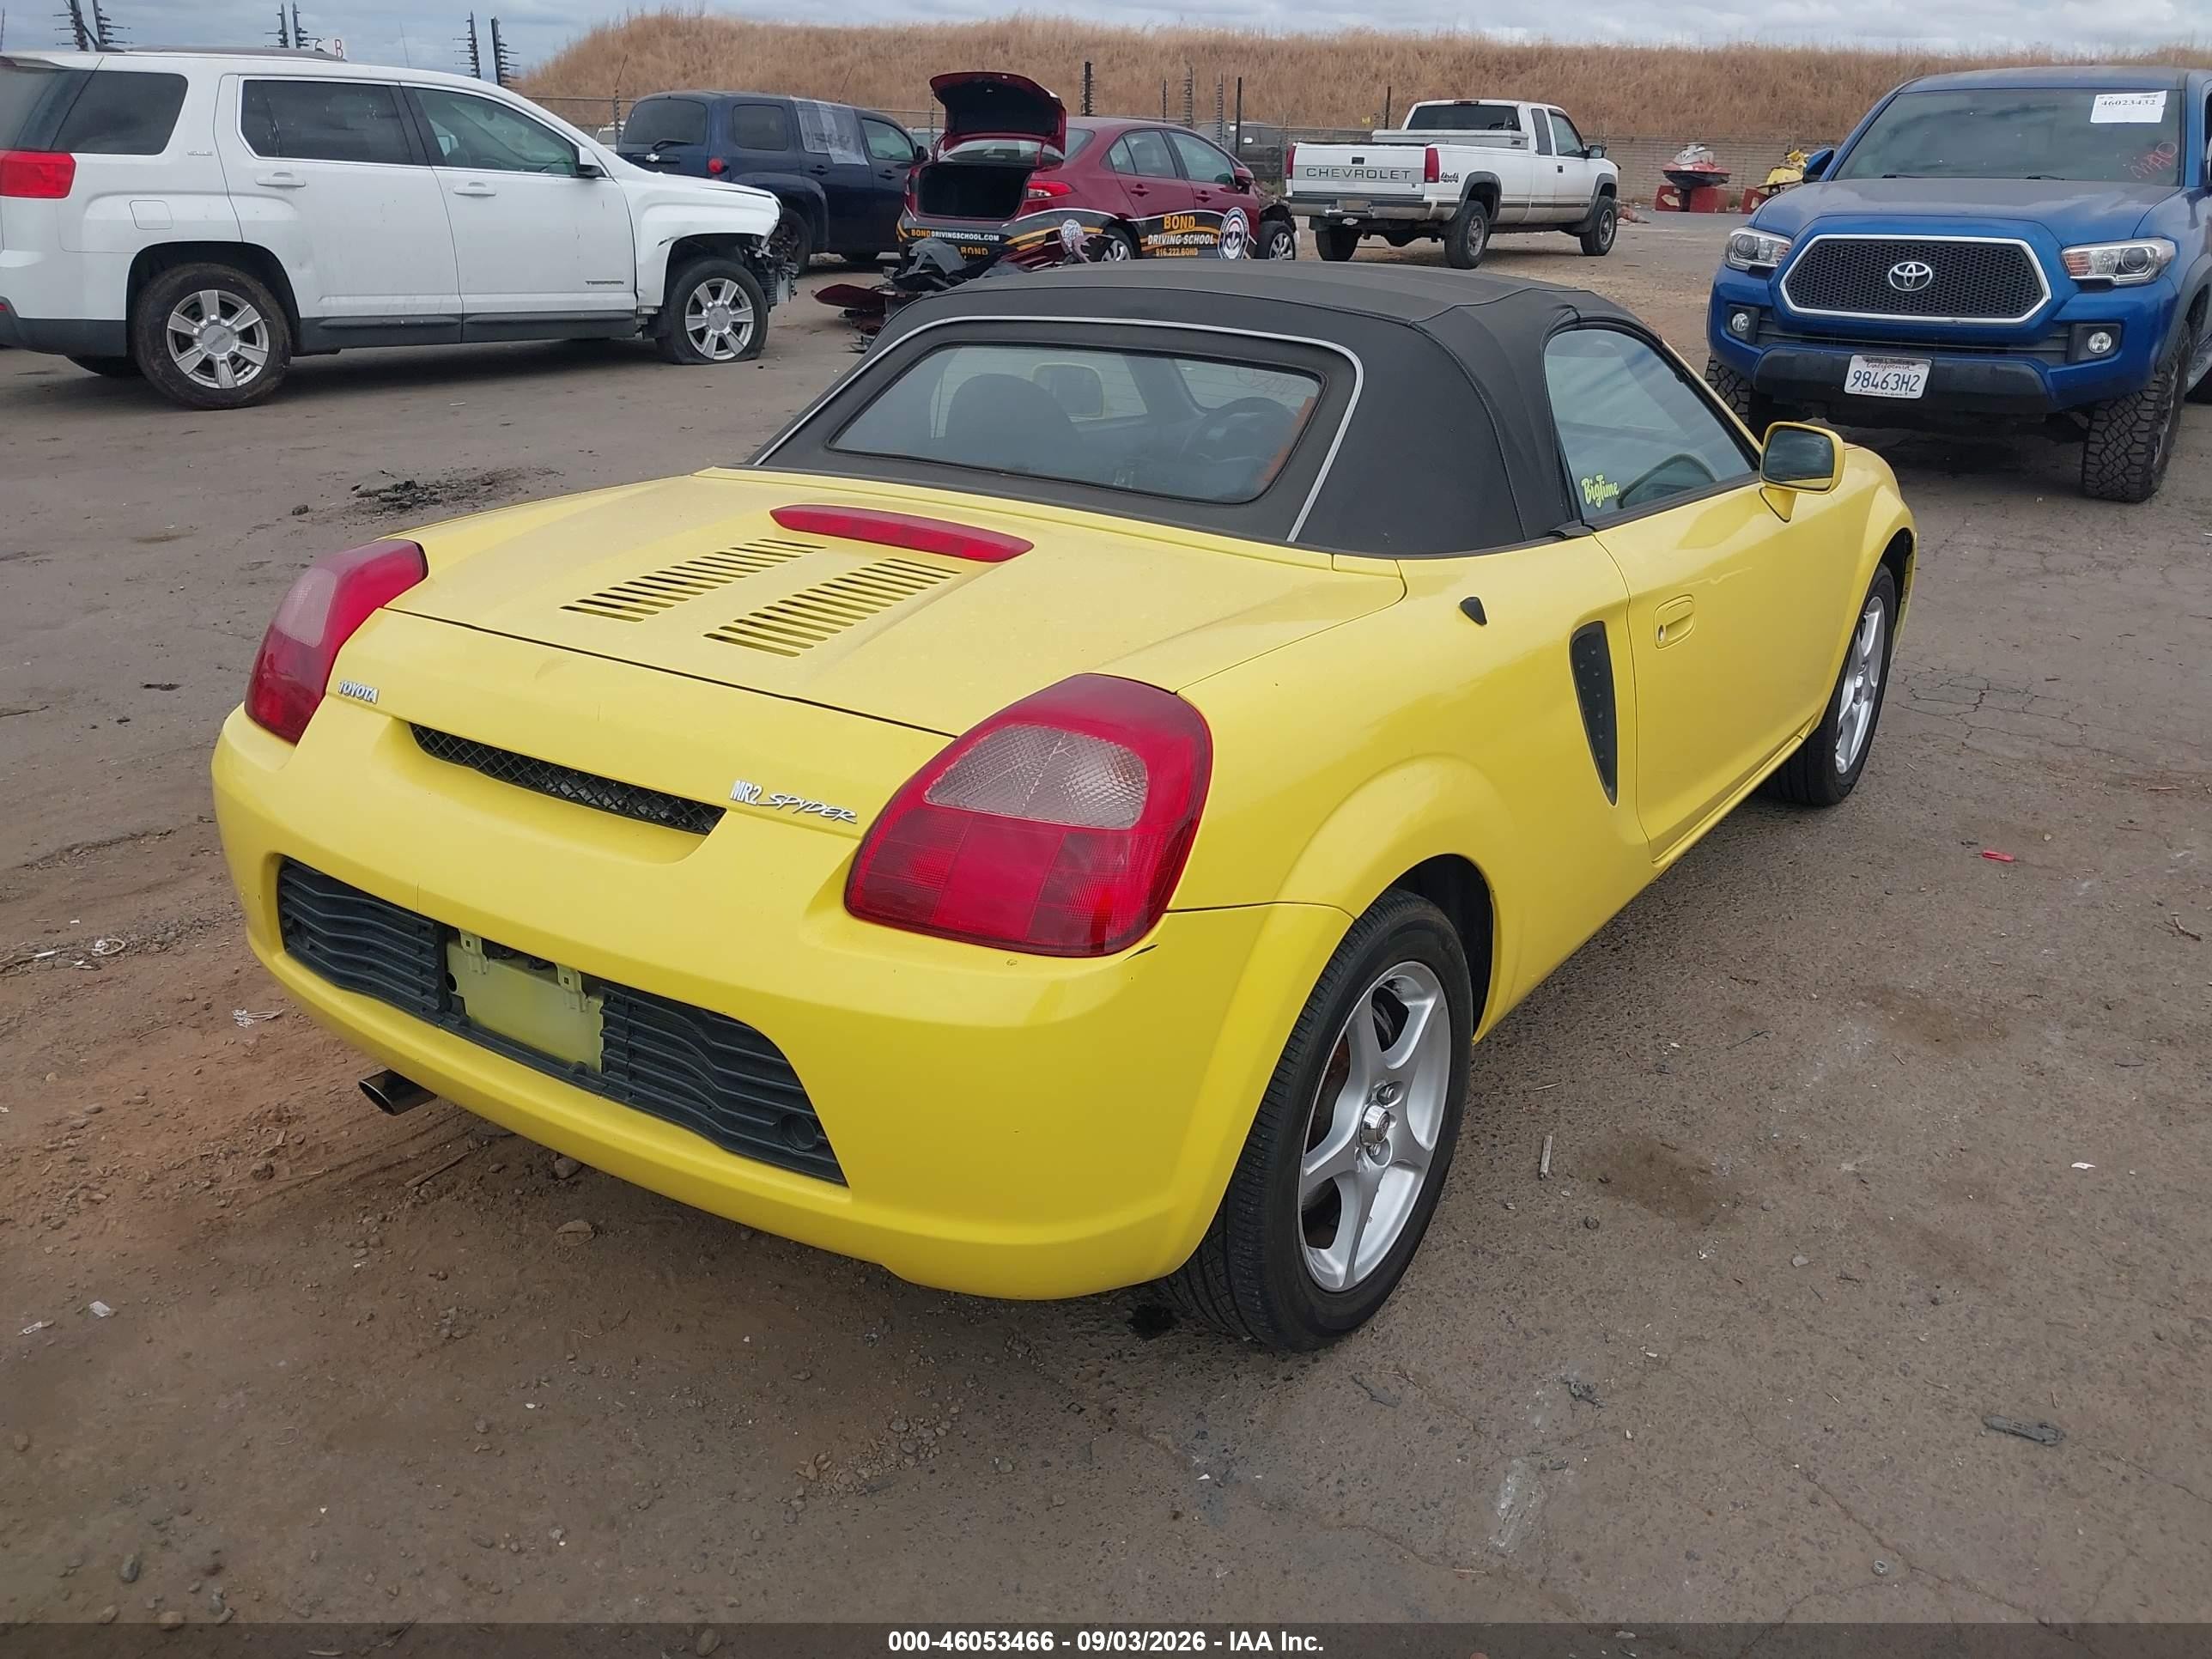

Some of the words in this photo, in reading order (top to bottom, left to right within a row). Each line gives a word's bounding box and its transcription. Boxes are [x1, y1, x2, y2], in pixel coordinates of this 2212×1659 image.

[1306, 167, 1411, 179] CHEVROLET
[1163, 215, 1196, 229] BOND
[1850, 370, 1921, 392] 98463H2
[337, 680, 380, 704] TOYOTA
[730, 780, 763, 805] MR2
[758, 793, 858, 824] SPYDER
